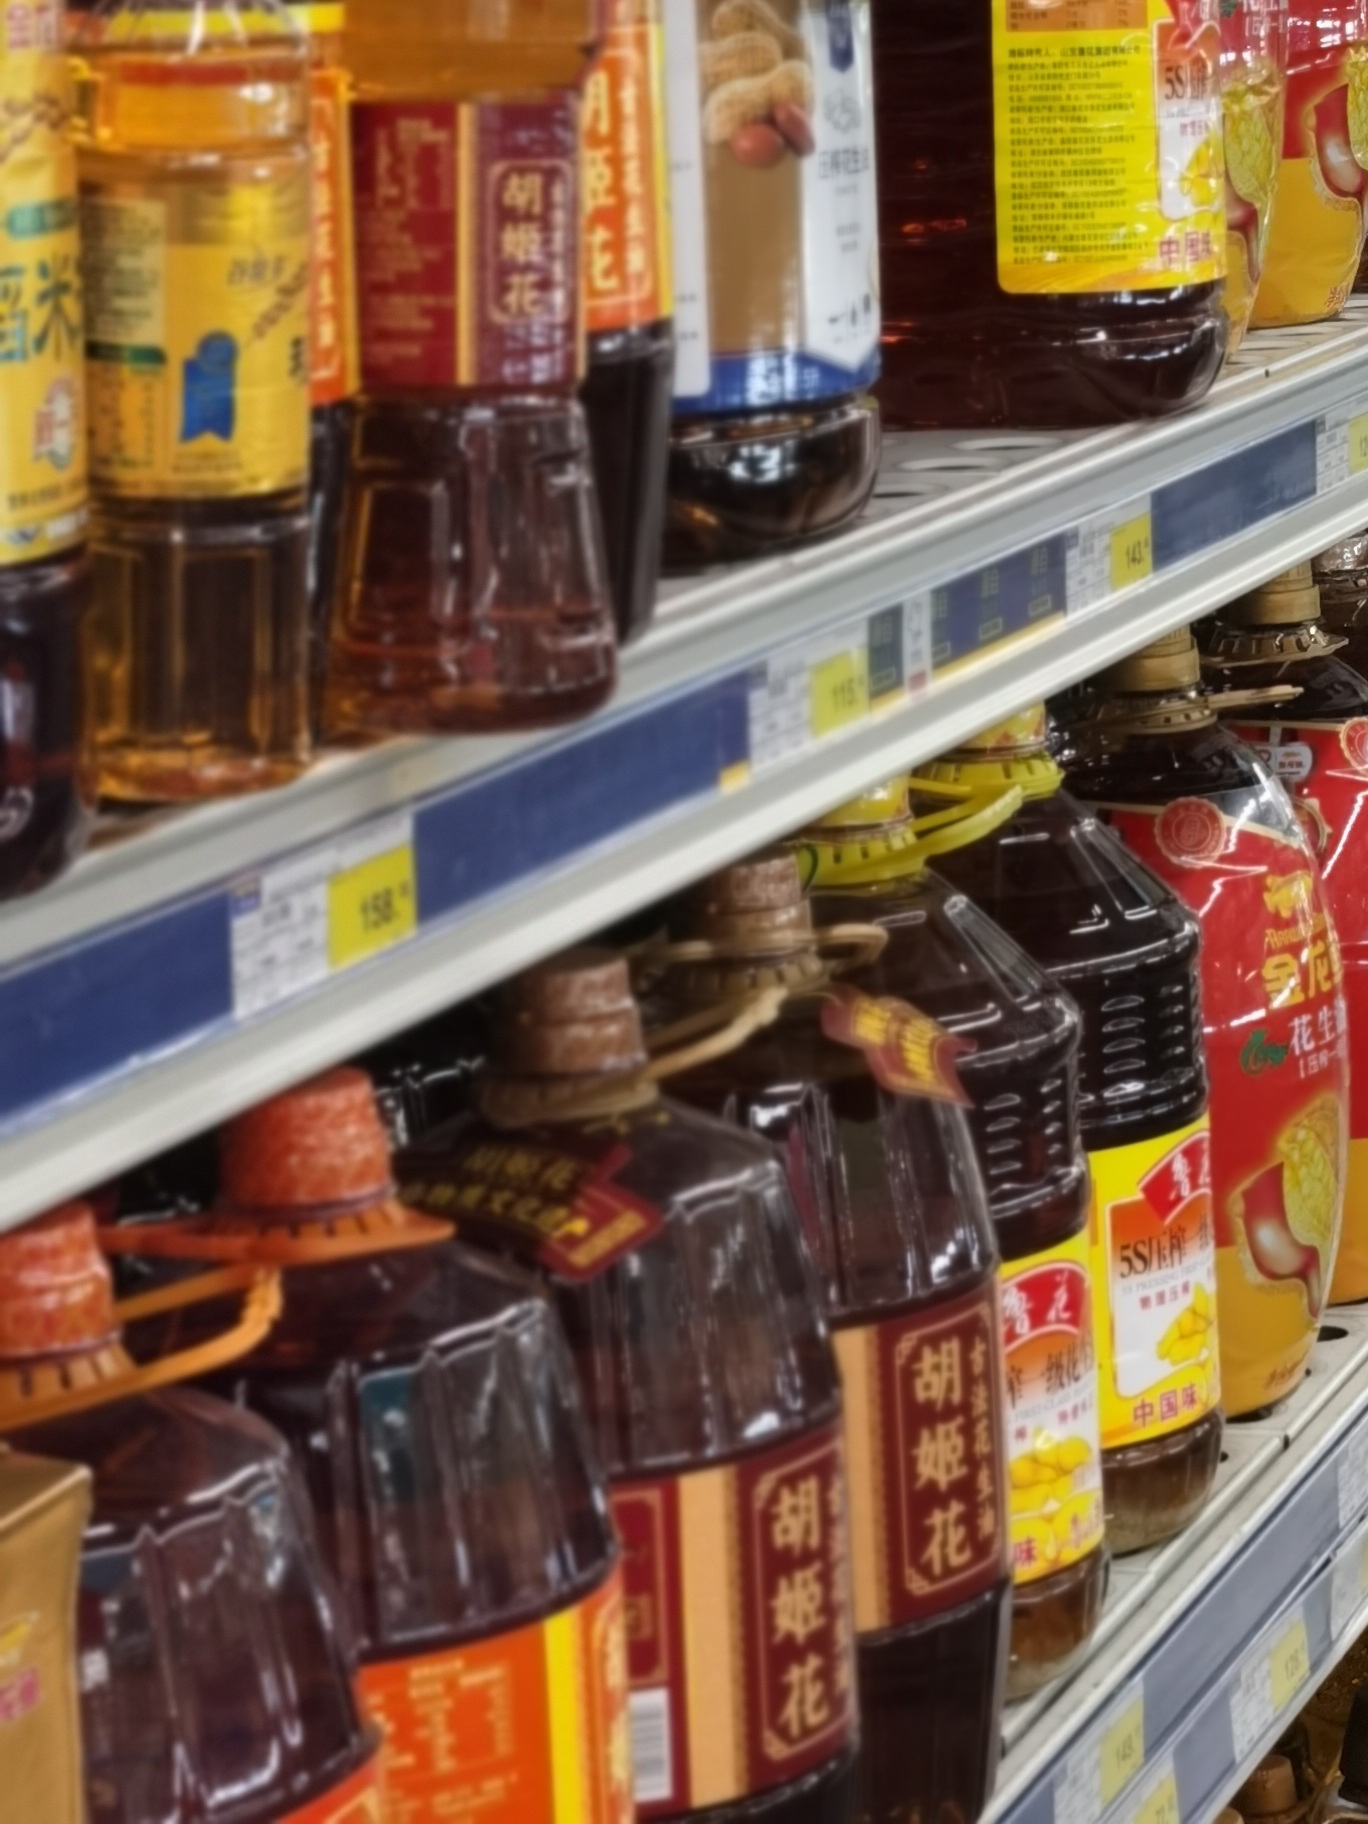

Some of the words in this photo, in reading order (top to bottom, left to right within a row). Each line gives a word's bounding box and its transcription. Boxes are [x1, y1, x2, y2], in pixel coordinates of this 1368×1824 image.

[912, 1336, 972, 1576] 胡姬花
[1132, 1388, 1198, 1430] 中国味
[770, 1476, 830, 1739] 胡姬花
